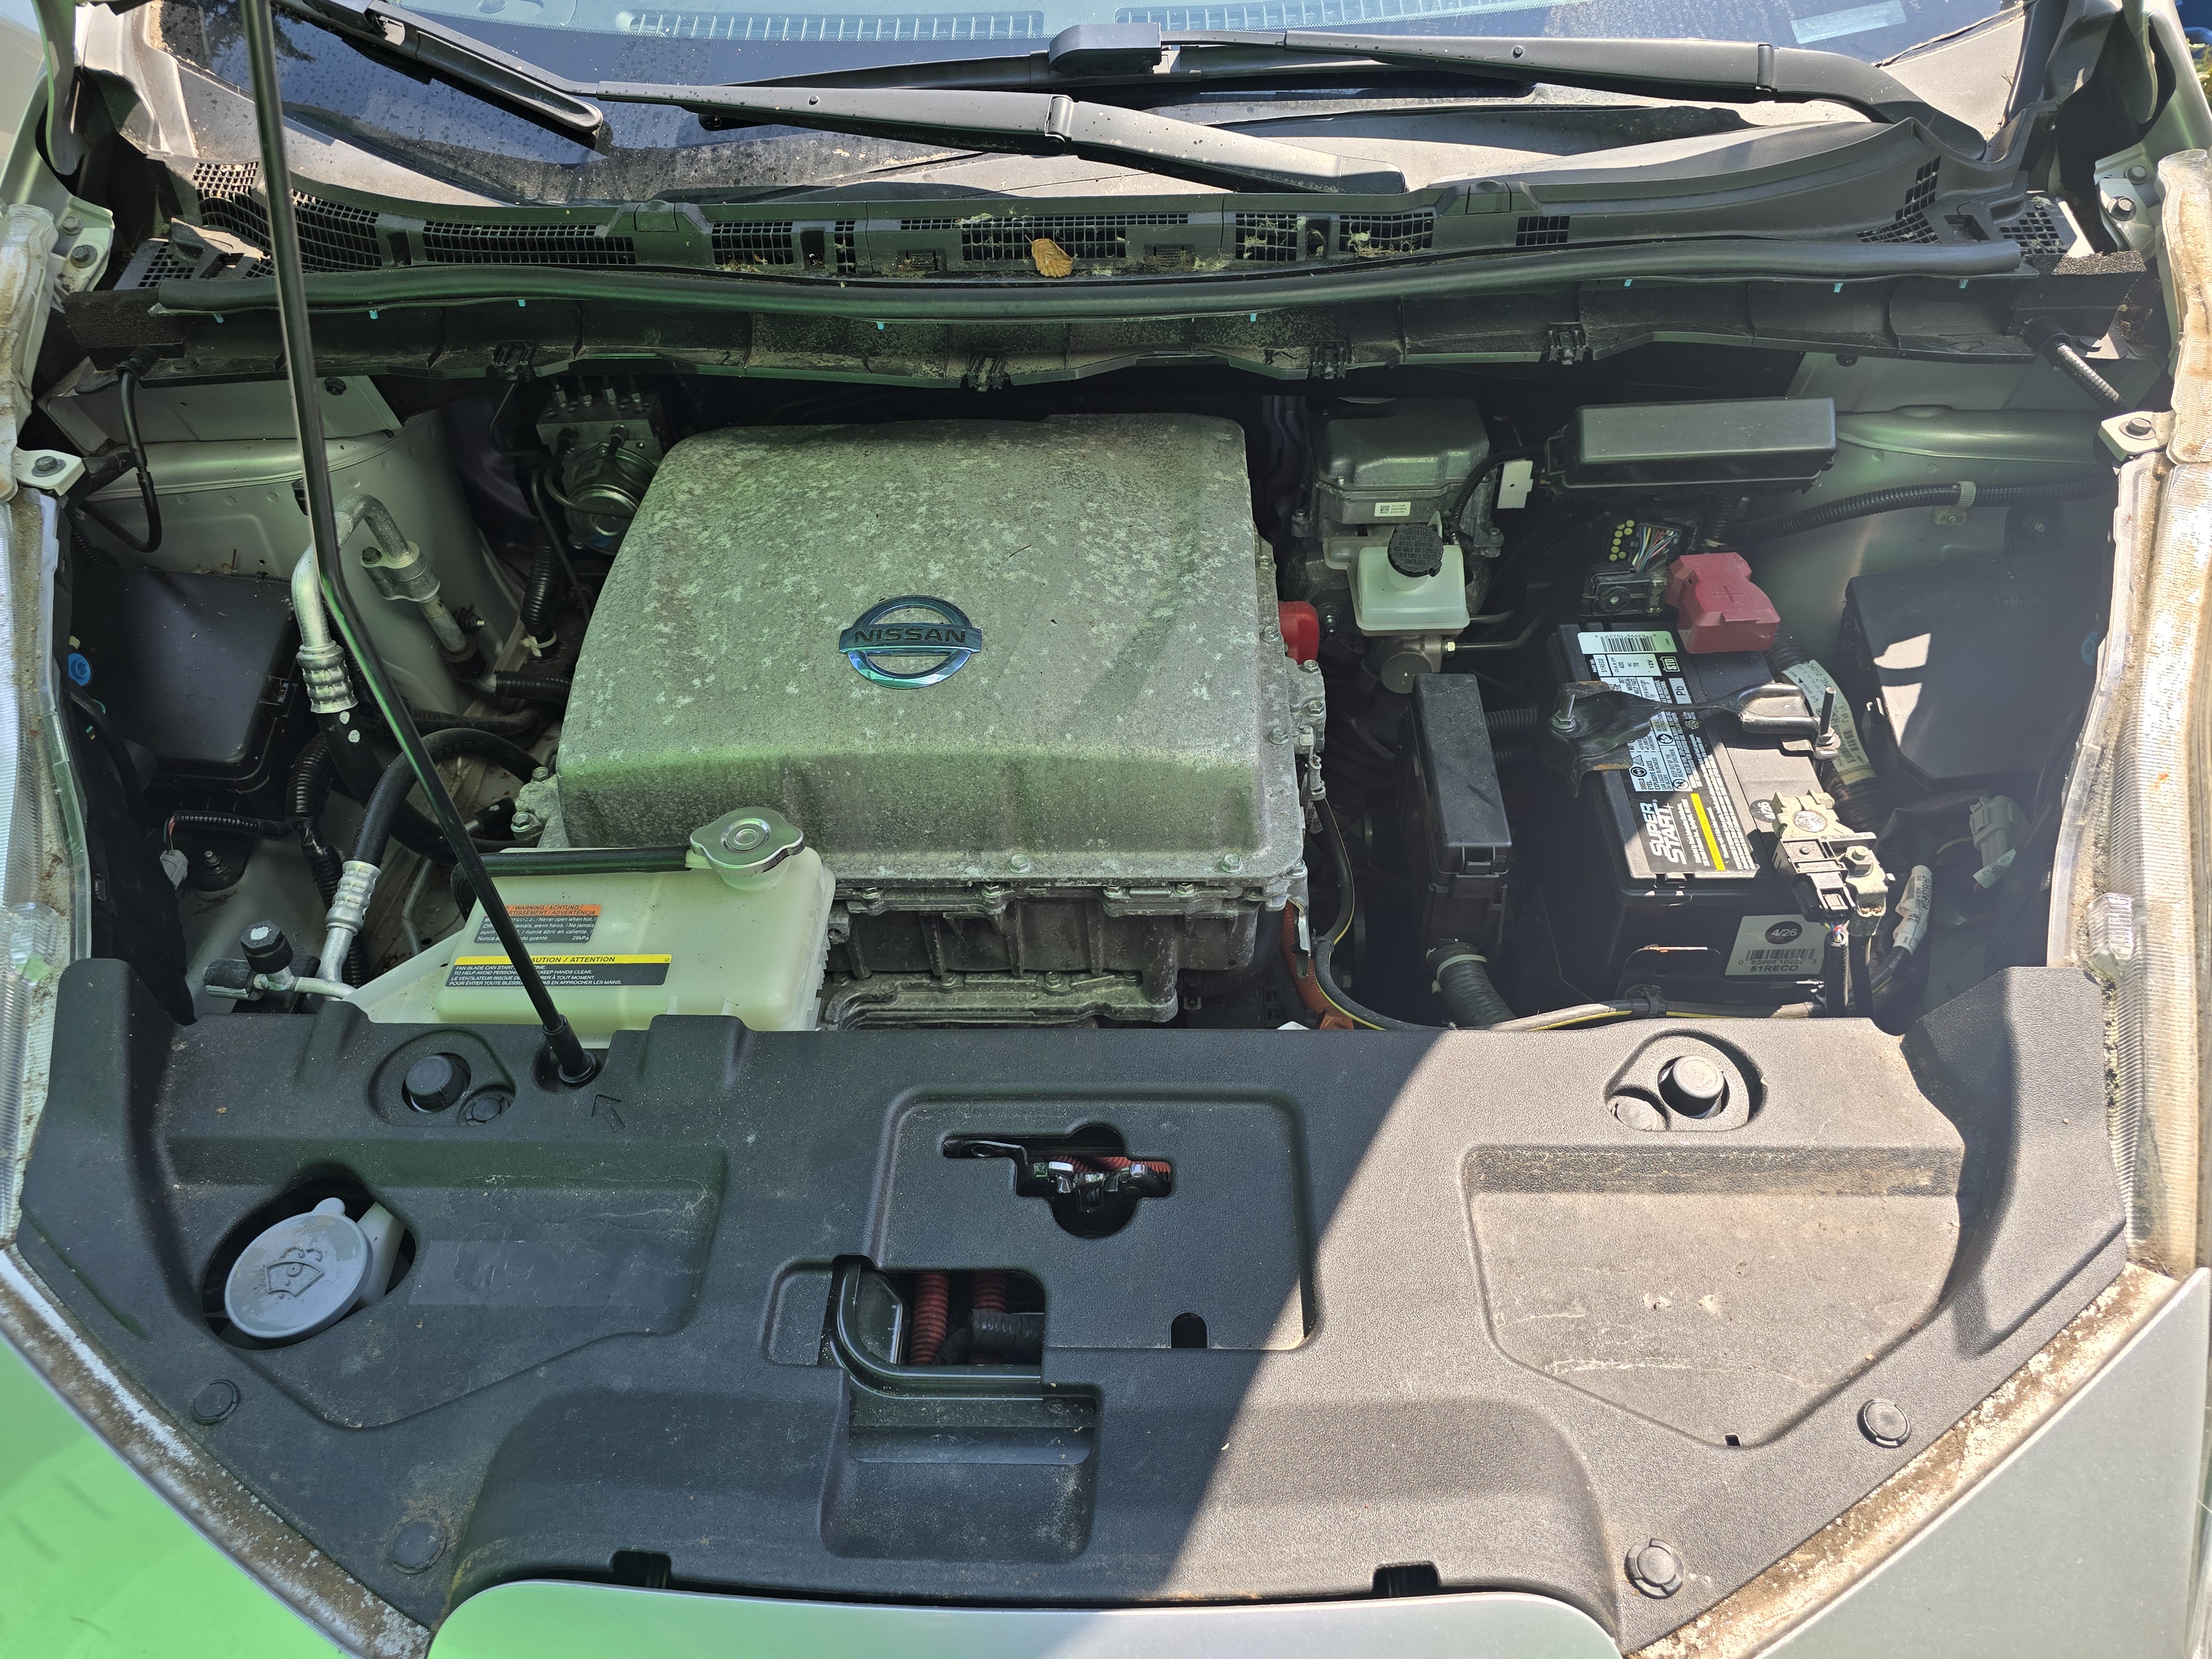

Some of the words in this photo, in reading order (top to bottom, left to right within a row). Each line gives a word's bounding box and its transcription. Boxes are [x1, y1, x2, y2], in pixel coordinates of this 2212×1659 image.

[543, 98, 571, 112] MICHELIN
[854, 628, 966, 643] NISSAN
[1664, 658, 1677, 670] STD
[1675, 686, 1686, 696] Pb
[1646, 761, 1655, 771] GASES
[1650, 772, 1661, 790] EXPLOSIVE
[1757, 802, 1776, 819] 4/26
[1640, 802, 1667, 857] SUPER
[1652, 802, 1687, 864] START
